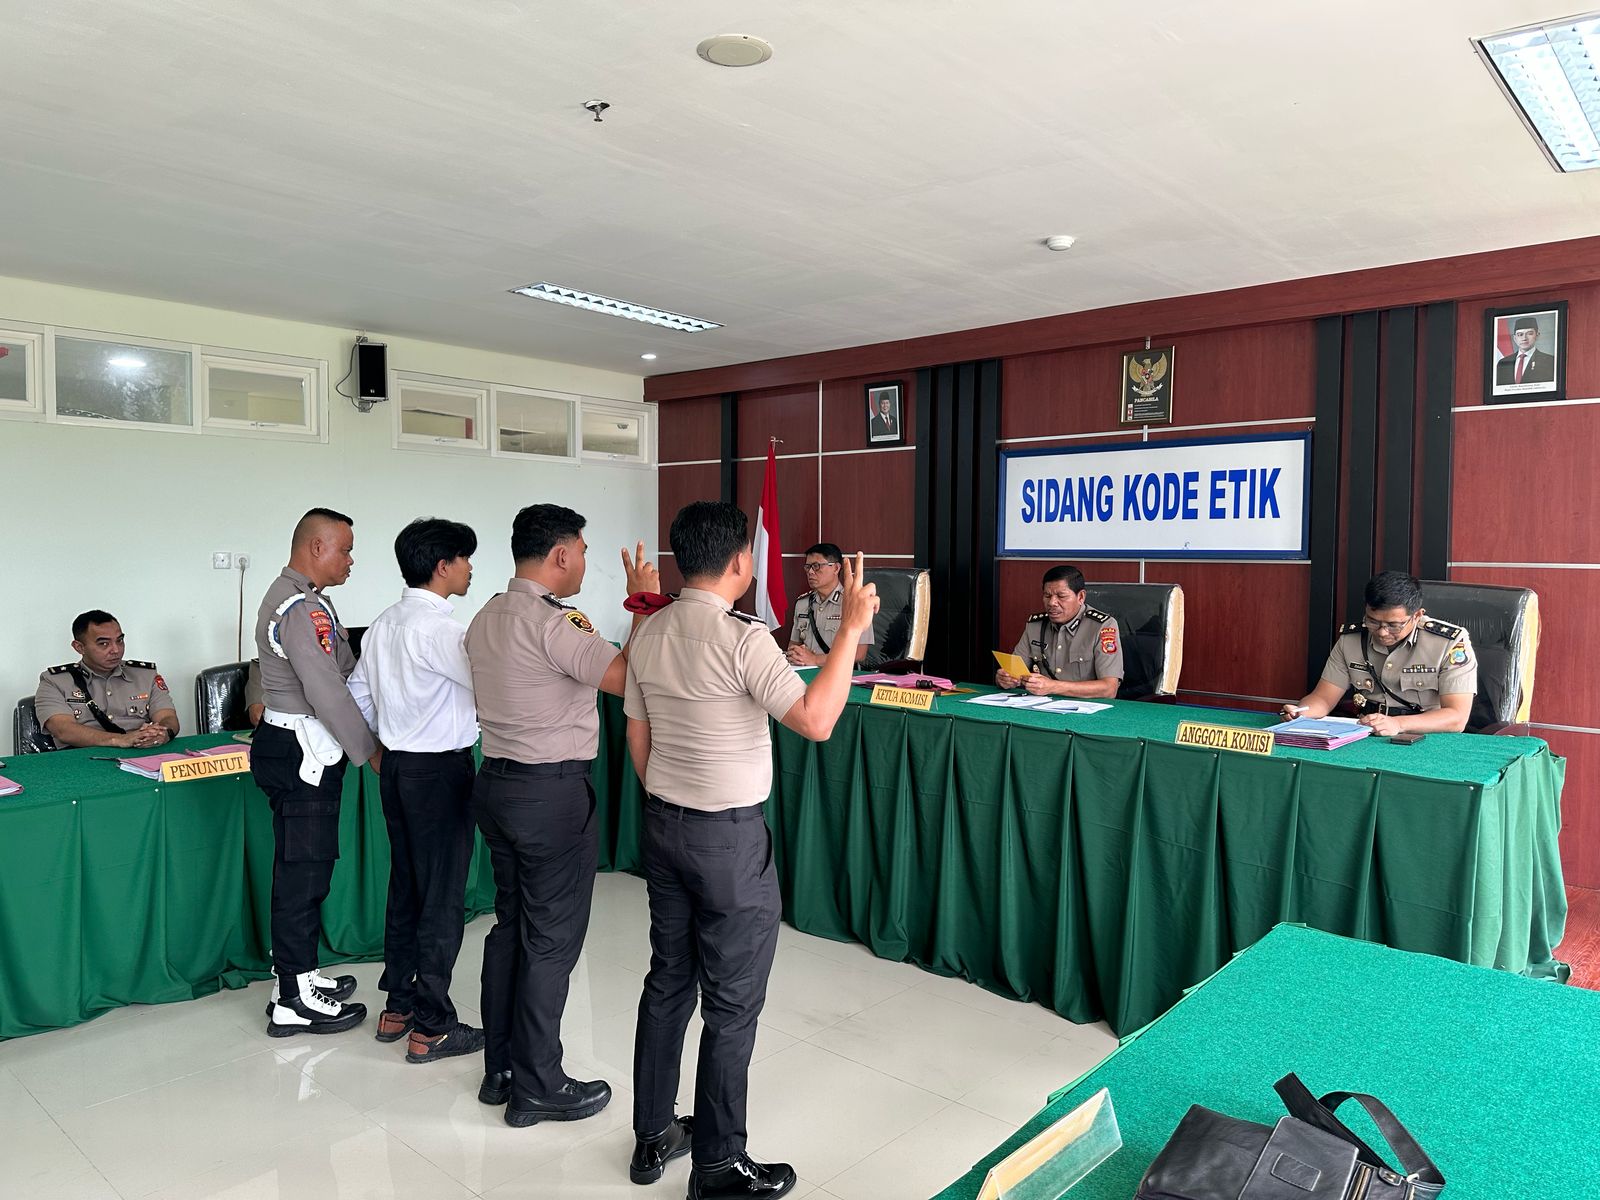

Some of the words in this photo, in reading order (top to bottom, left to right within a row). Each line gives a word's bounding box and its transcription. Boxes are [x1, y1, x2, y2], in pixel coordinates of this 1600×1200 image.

[1021, 475, 1114, 523] SIDANG
[1122, 471, 1200, 521] KODE
[1209, 467, 1282, 520] ETIK
[875, 688, 899, 703] KETUA
[899, 691, 929, 706] KOMISI
[1180, 726, 1228, 748] ANGGOTA
[1231, 731, 1271, 753] KOMISI
[170, 756, 243, 779] PENUNTUT
